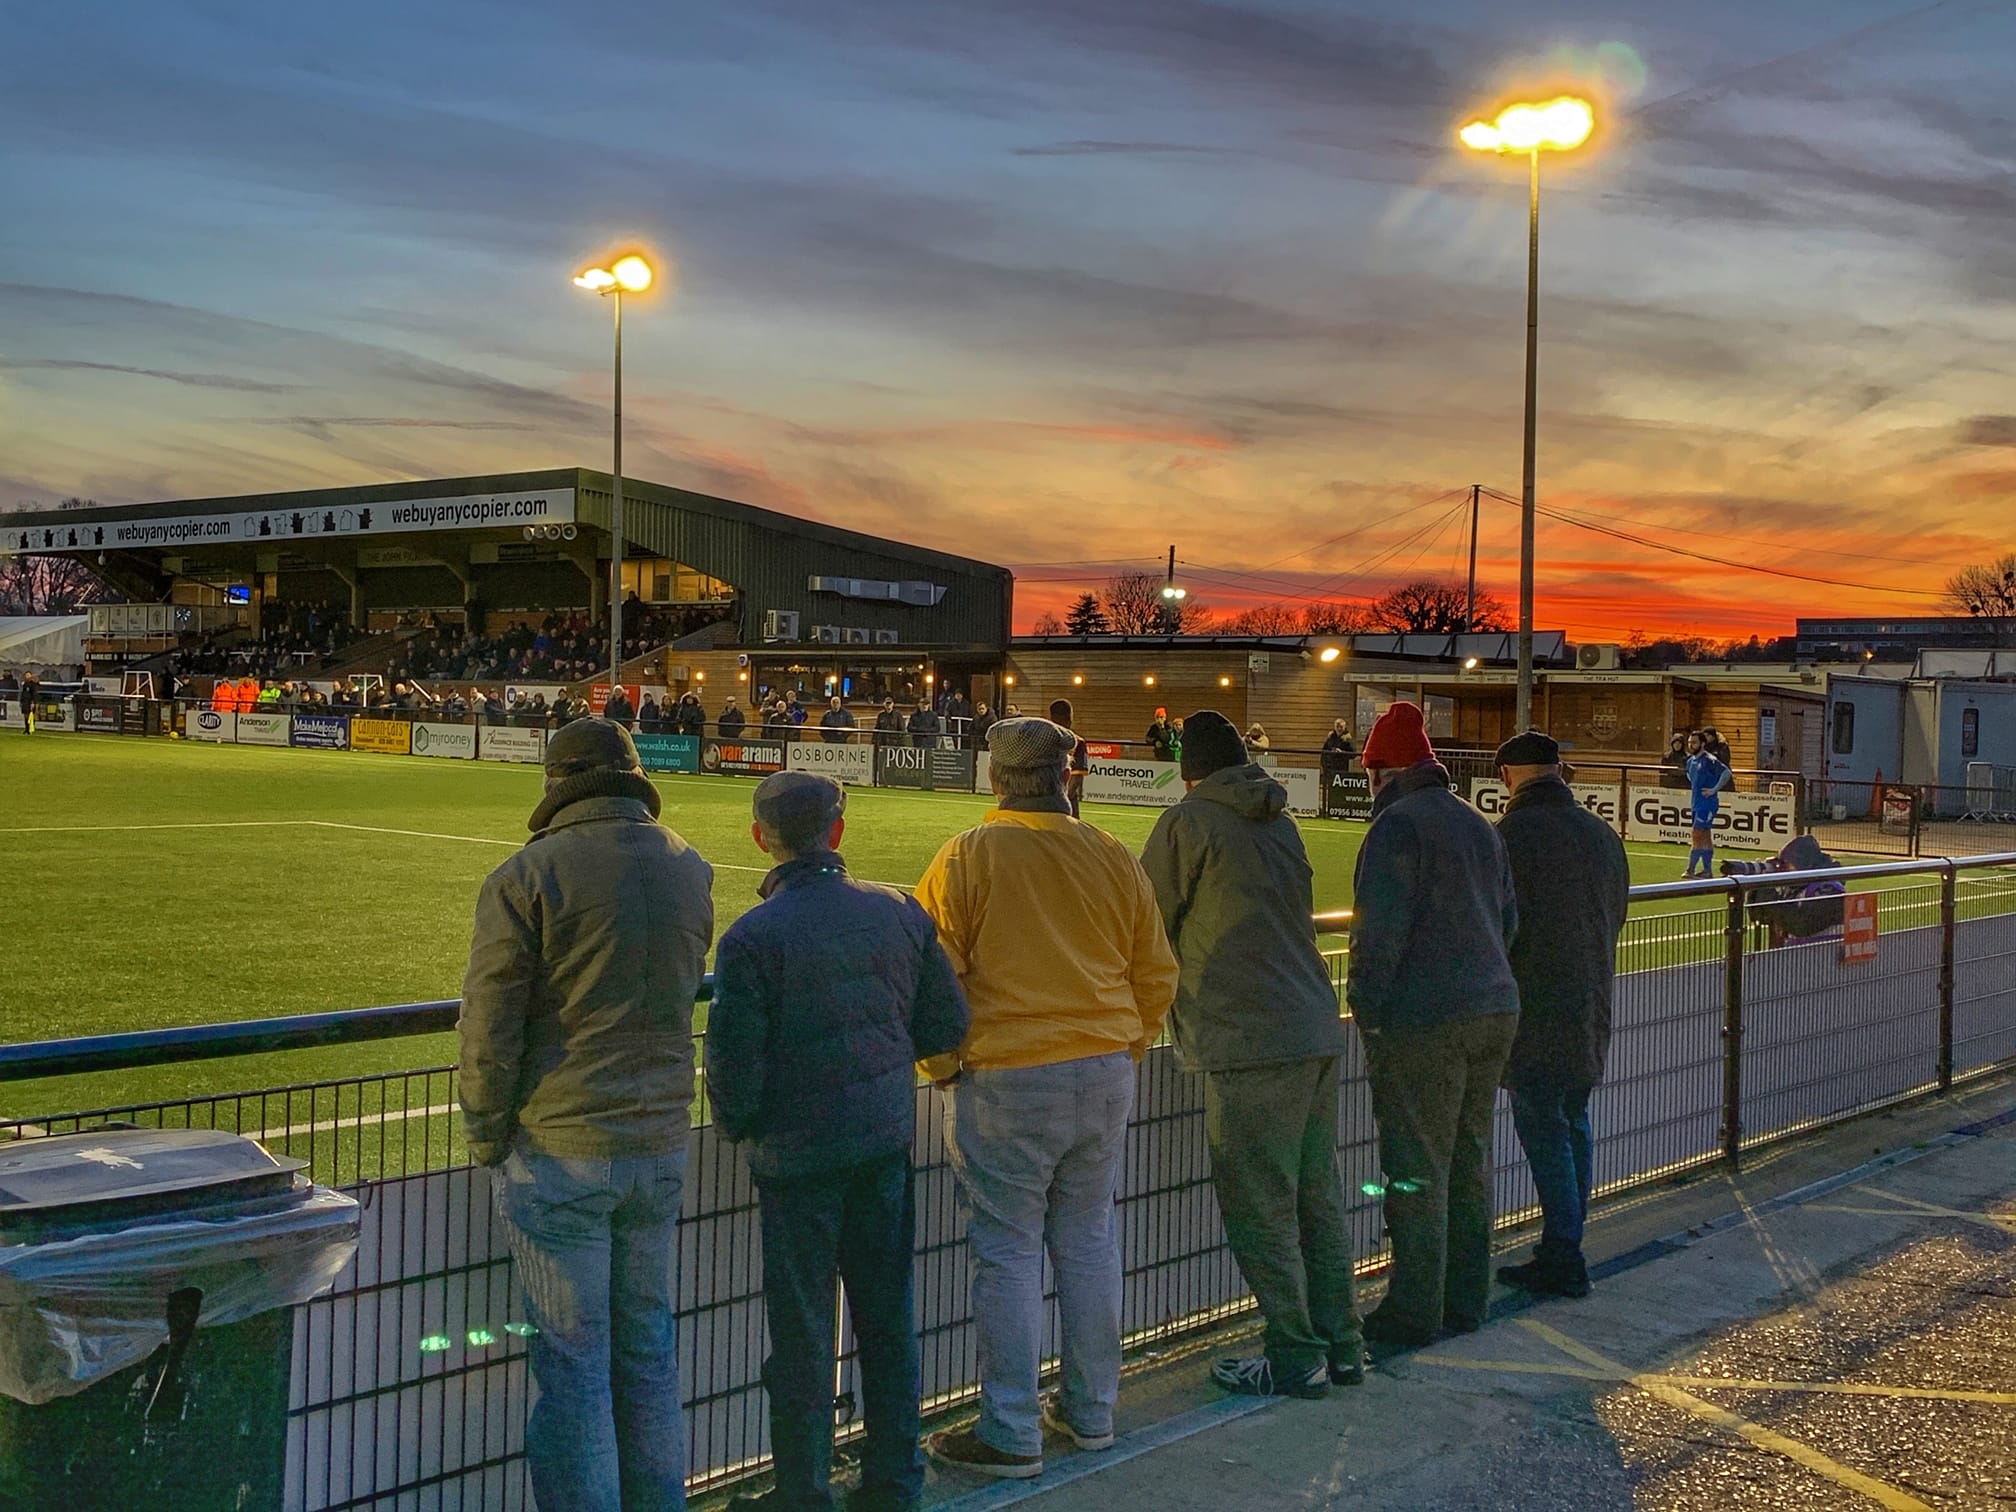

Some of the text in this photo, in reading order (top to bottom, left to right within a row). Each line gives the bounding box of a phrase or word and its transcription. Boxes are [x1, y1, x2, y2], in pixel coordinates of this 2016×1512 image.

[393, 499, 548, 526] webuyanycopier.com
[117, 520, 231, 543] webuyanycopier.com
[240, 718, 271, 726] Anderson
[720, 743, 781, 763] vanarama
[792, 748, 866, 764] OSBORNE
[1087, 746, 1112, 754] ANDING
[886, 748, 925, 769] POSH
[841, 768, 869, 776] BUILDERS
[1089, 764, 1154, 779] Anderson
[1273, 771, 1307, 780] decorating
[1120, 779, 1153, 790] TRAVEL
[1086, 791, 1178, 804] www.andersontravel.co
[1659, 829, 1761, 845] Heatin Plumbing
